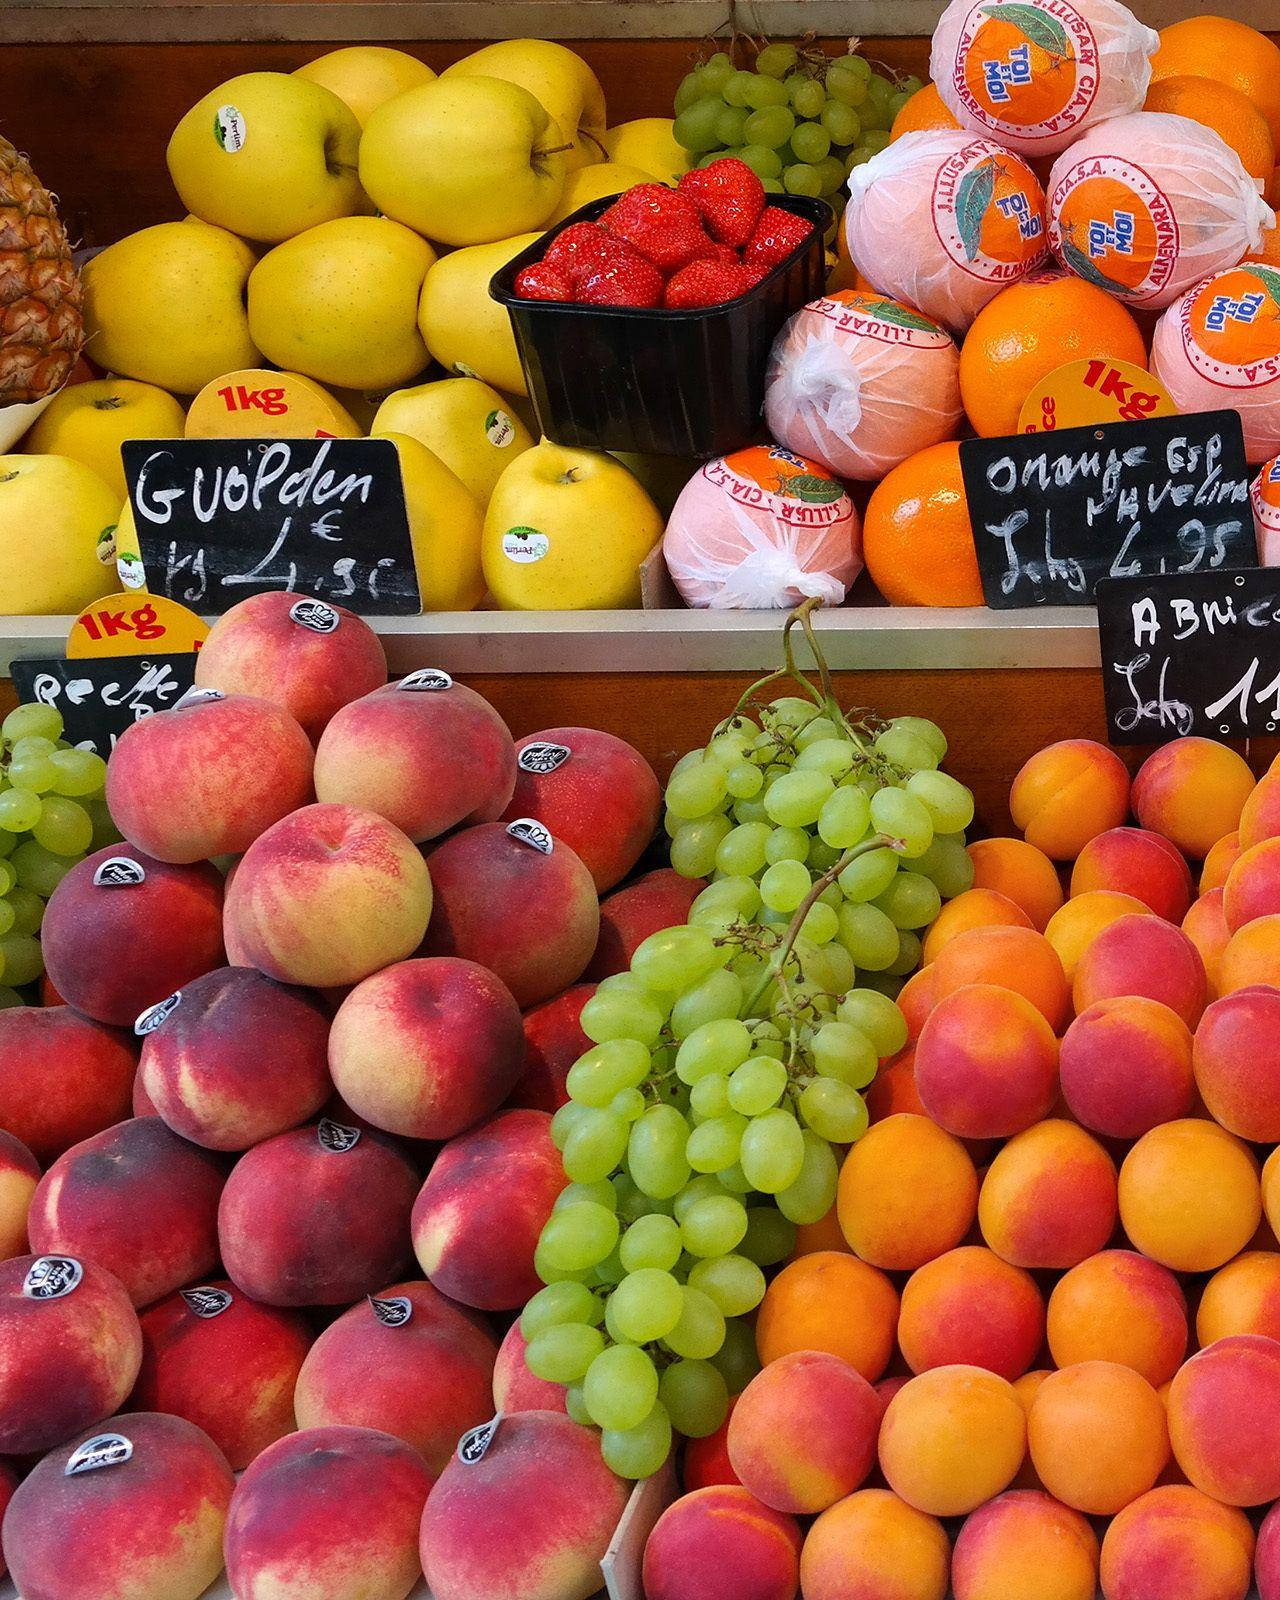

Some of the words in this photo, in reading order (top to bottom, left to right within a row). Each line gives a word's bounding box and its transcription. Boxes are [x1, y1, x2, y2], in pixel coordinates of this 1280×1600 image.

[1000, 65, 1013, 82] ET
[1009, 44, 1031, 84] TOI
[984, 61, 1009, 102] MOI
[231, 119, 242, 150] Perlim
[997, 192, 1027, 216] TOI
[1018, 210, 1029, 221] ET
[1019, 215, 1042, 238] MOI
[1089, 220, 1105, 257] TOI
[1105, 227, 1115, 246] ET
[1114, 211, 1133, 252] MOI
[1206, 296, 1230, 331] MOI
[1226, 302, 1239, 317] ET
[1235, 293, 1264, 322] TOI
[217, 385, 288, 416] 1kg
[1083, 360, 1160, 421] 1kg
[79, 603, 166, 641] 1kg
